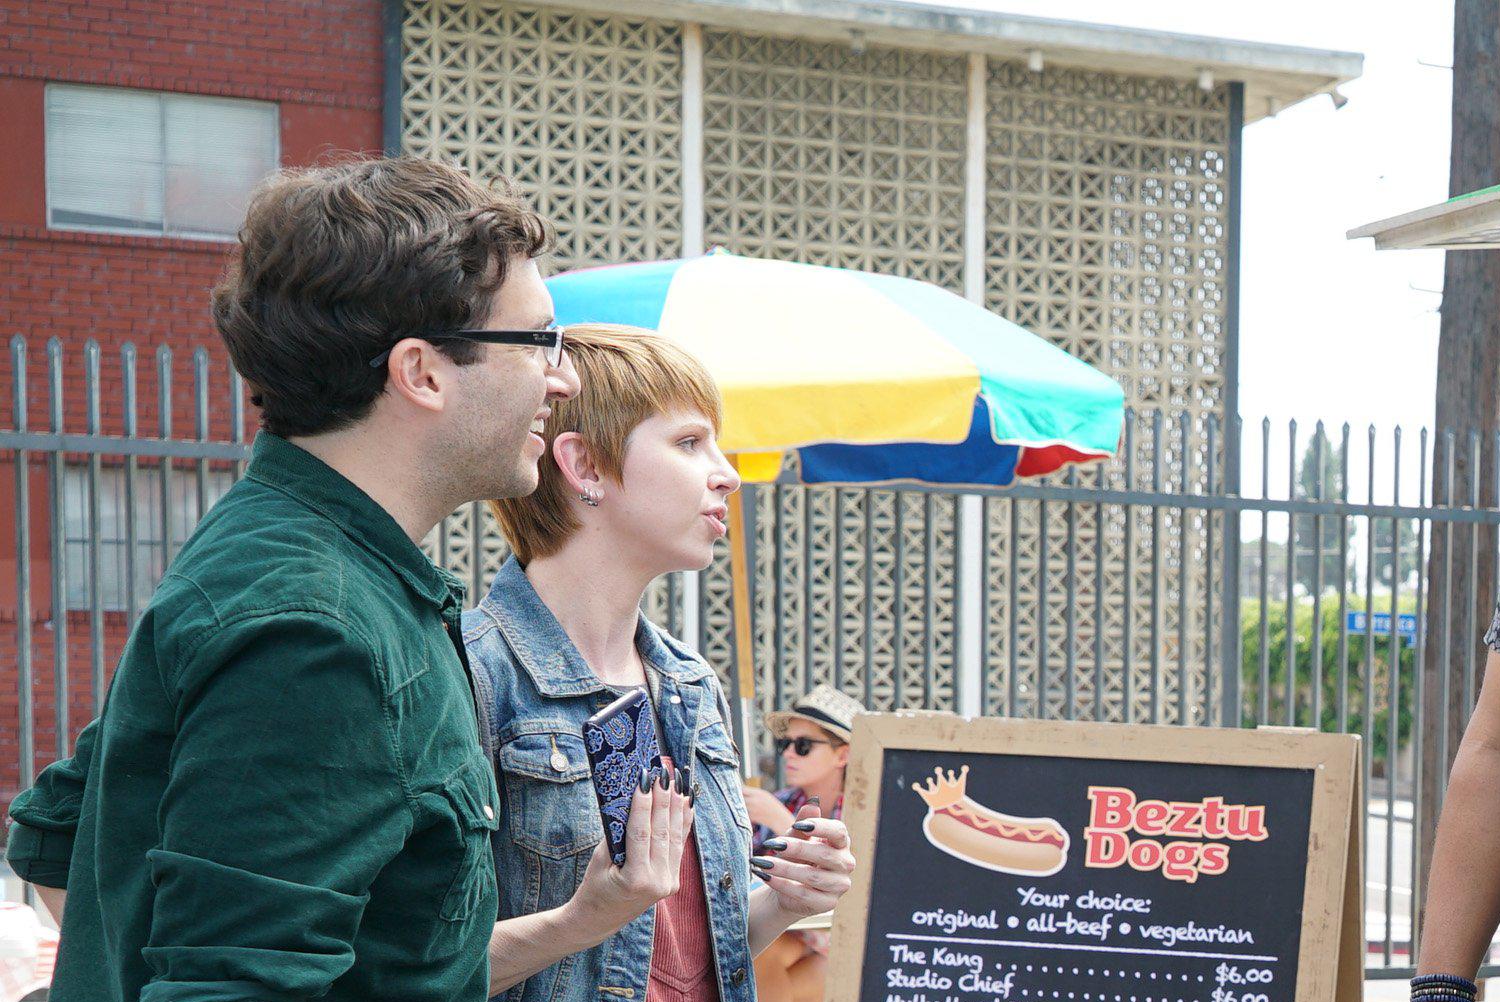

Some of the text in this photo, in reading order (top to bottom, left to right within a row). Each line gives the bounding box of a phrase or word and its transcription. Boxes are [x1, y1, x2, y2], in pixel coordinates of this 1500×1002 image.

[1085, 785, 1270, 842] Beztu
[1083, 829, 1230, 884] Dogs
[1016, 886, 1152, 914] Your choice:
[911, 908, 1254, 947] original all-beef vegetarian
[886, 968, 953, 990] Studio
[958, 971, 1016, 999] Chief
[889, 944, 1274, 986] The Kang $6.00
